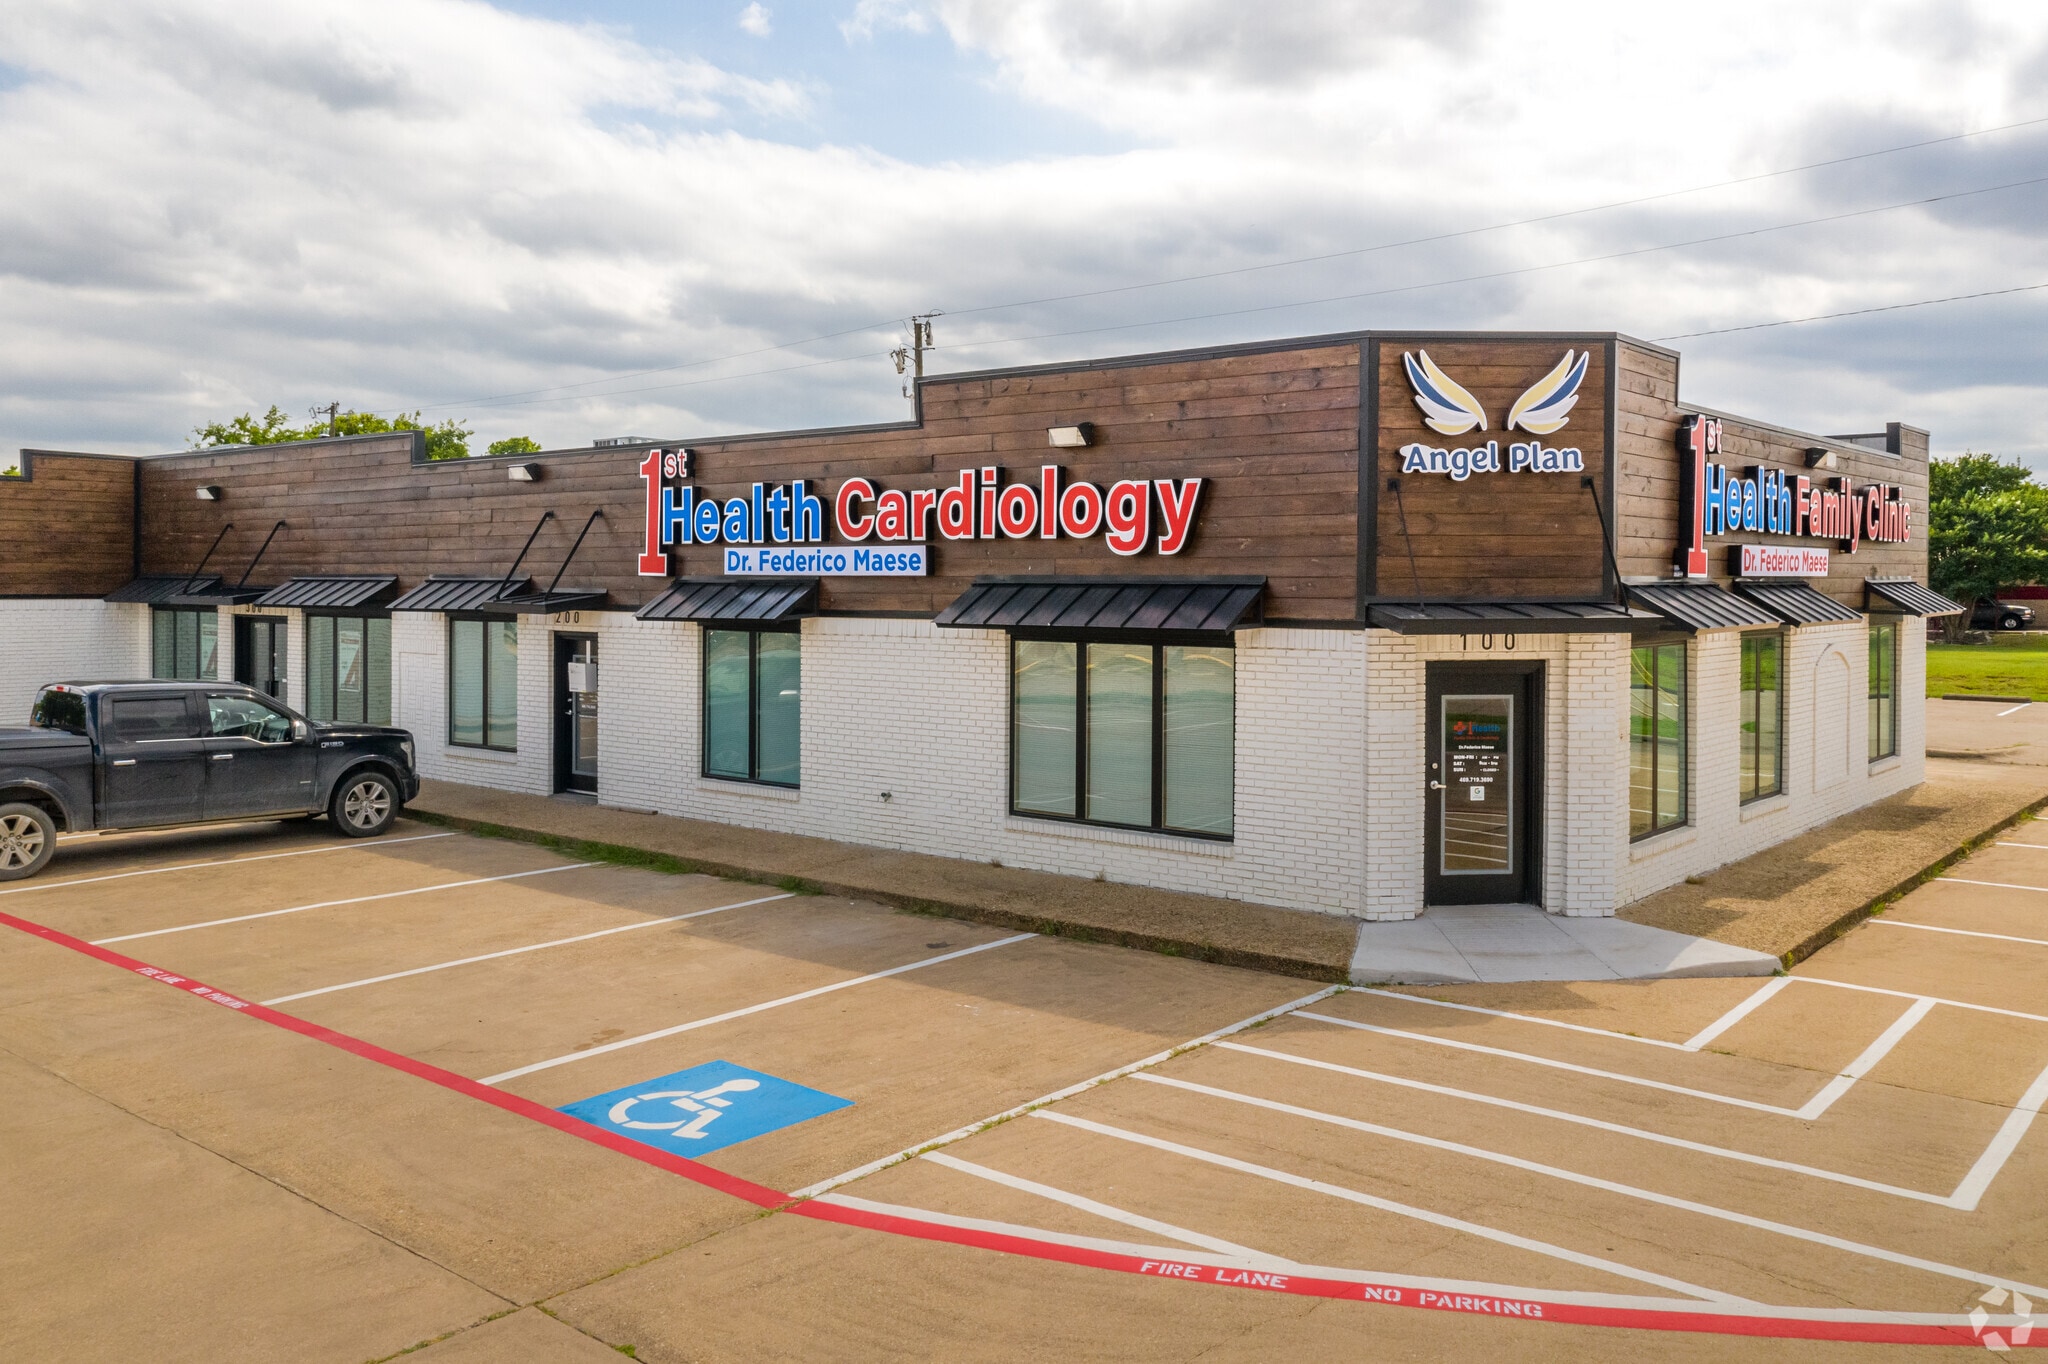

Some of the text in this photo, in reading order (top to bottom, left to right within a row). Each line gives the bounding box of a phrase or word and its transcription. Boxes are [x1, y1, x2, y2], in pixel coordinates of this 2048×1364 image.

[1404, 442, 1583, 480] Angel Plan
[662, 465, 1202, 556] Health Cardiology
[1687, 414, 1723, 577] 1st
[1704, 462, 1911, 554] Health Family Clinic
[638, 448, 688, 577] 1st
[727, 549, 922, 572] Dr. Federico Maese
[1743, 549, 1828, 572] Dr. Federico Maese
[556, 611, 580, 623] 200
[1460, 633, 1515, 650] 100
[1140, 1262, 1289, 1289] FIRE LANE
[1365, 1286, 1543, 1318] NO PARKING
